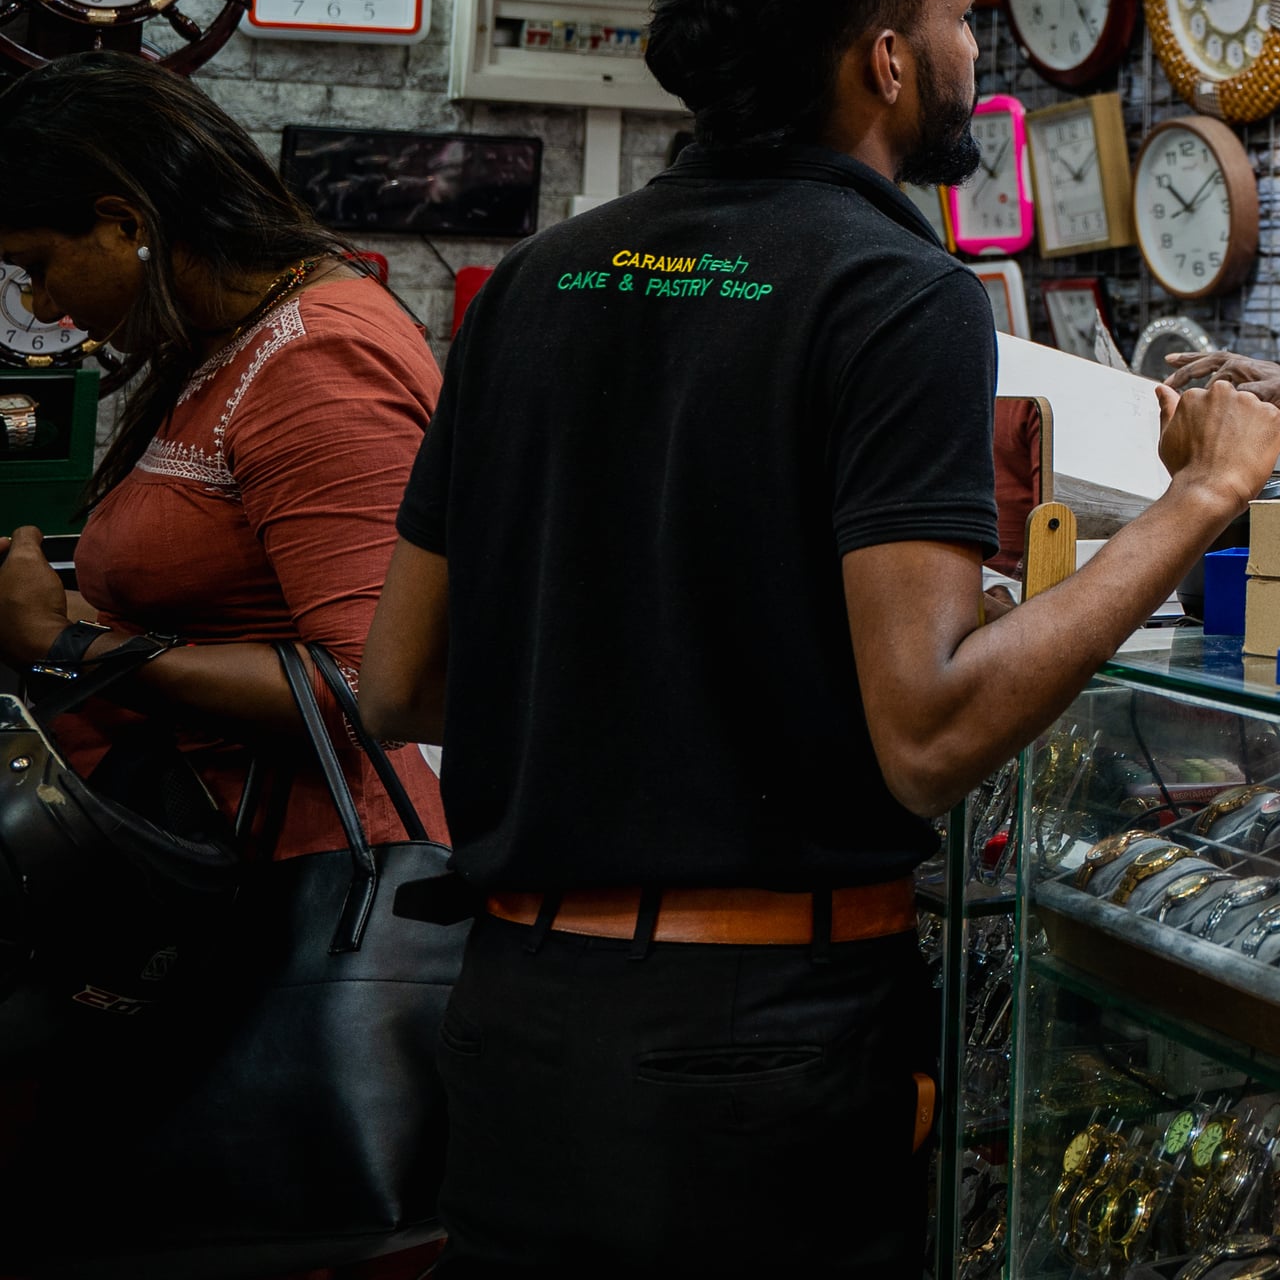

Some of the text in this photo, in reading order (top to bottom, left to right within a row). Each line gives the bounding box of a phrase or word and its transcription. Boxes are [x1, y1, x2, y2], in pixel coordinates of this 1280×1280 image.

[612, 249, 697, 273] CARAVAN
[557, 271, 773, 301] CAKE & PASTRY SHOP
